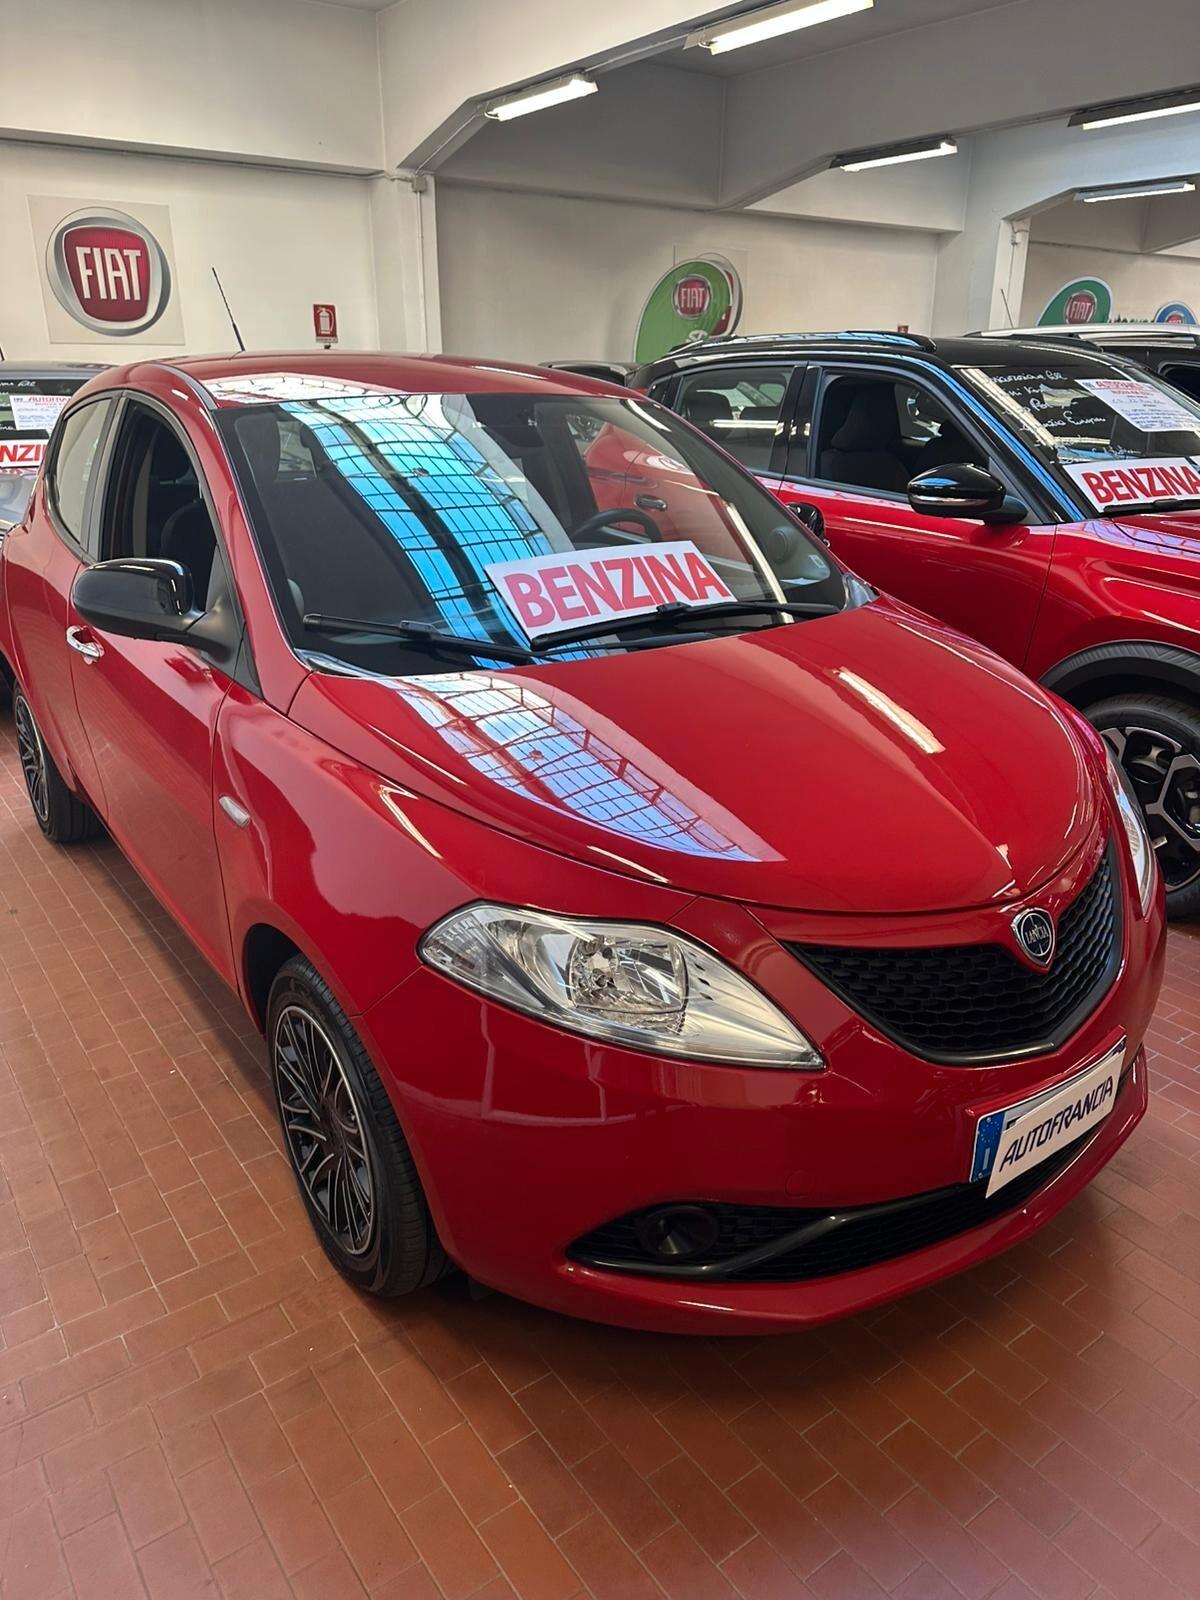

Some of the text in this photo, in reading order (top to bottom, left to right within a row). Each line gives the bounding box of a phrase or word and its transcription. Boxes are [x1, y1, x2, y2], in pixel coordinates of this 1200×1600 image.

[75, 246, 141, 301] FIAT
[681, 287, 705, 308] FIAT
[1071, 301, 1091, 320] FIAT
[1081, 466, 1200, 503] BENZINA
[503, 552, 731, 628] BENZINA
[999, 1076, 1113, 1173] AUTOFRANCIA
